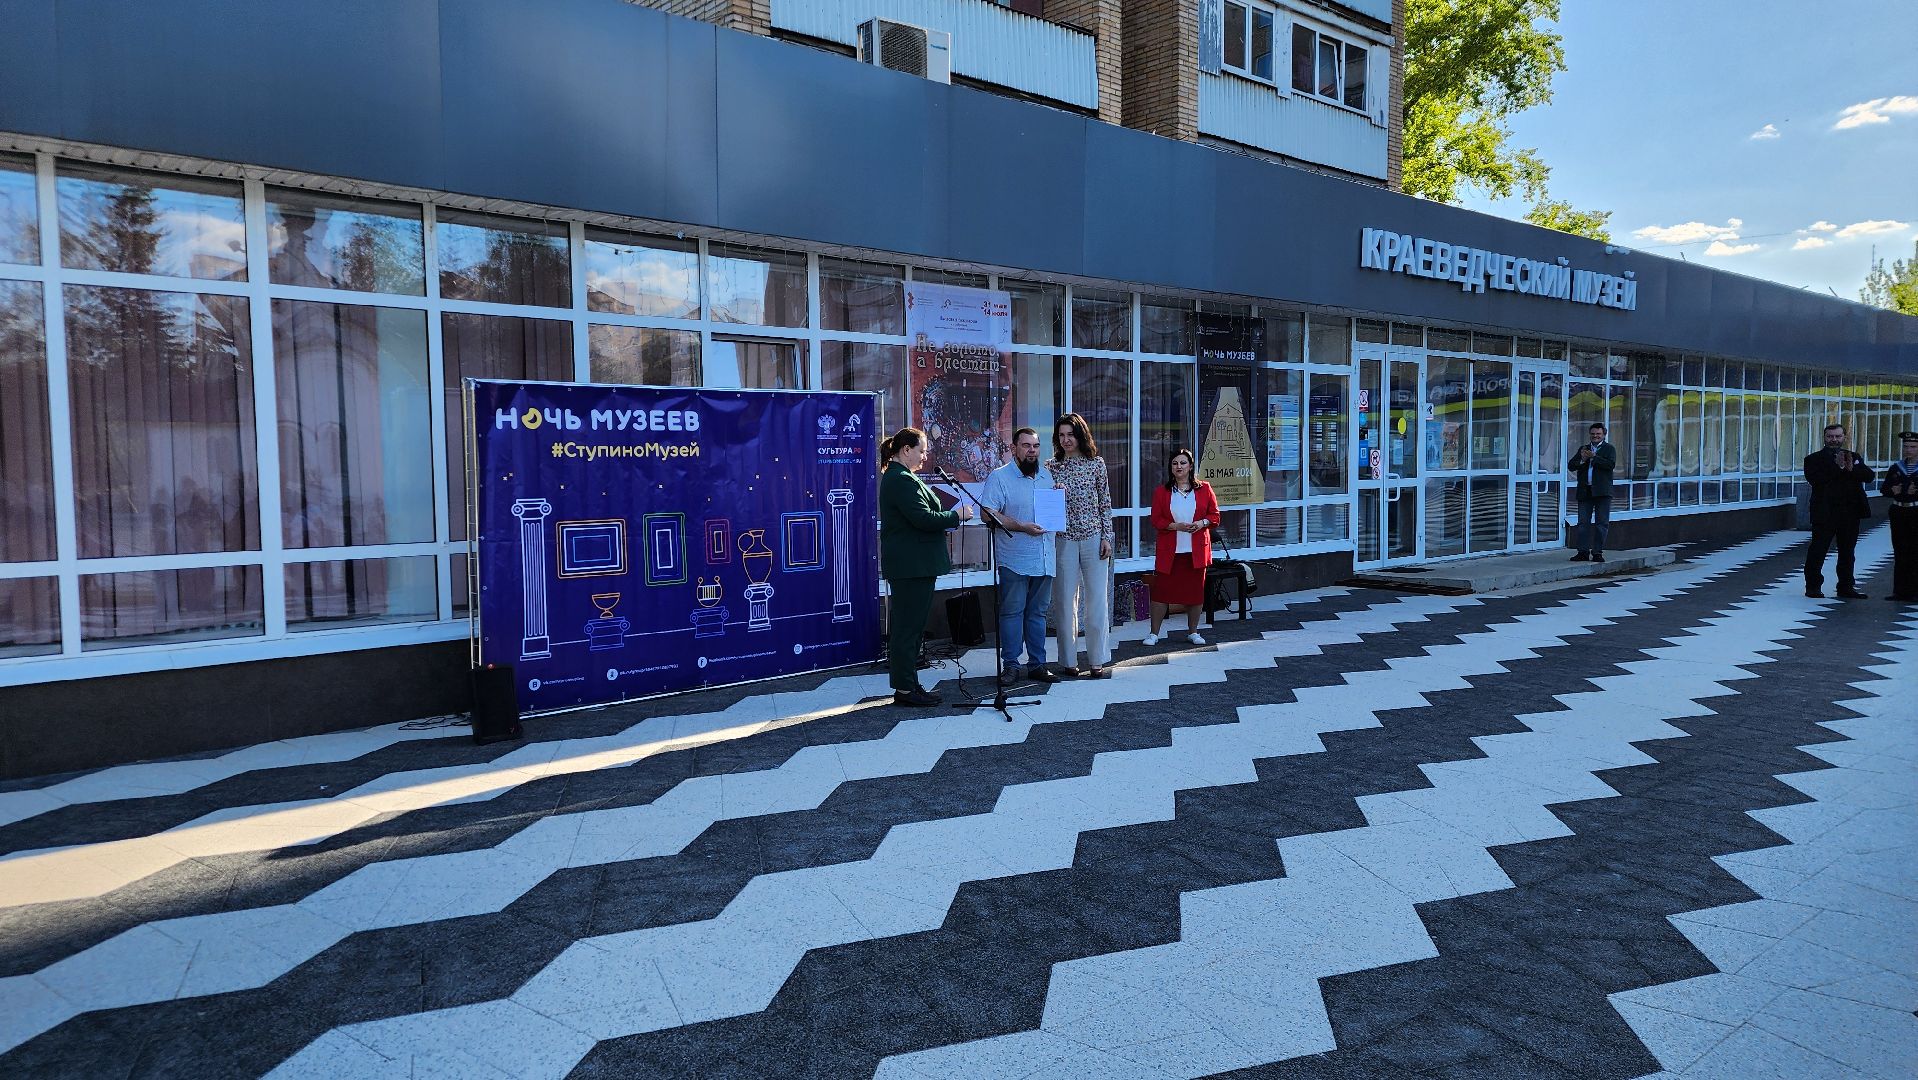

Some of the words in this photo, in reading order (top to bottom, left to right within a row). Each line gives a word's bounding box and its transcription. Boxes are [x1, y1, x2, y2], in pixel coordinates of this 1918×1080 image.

[1361, 227, 1570, 300] КРАЕВЕДЧЕСКИЙ
[1571, 270, 1637, 311] МУЗЕЙ
[917, 355, 927, 368] а
[1203, 349, 1225, 359] НОЧЬ
[1226, 350, 1256, 361] МУЗЕЕВ
[495, 407, 582, 430] НОЧЬ
[590, 409, 700, 431] МУЗЕЕВ
[551, 441, 700, 462] #СтупиноМузей
[1205, 468, 1215, 479] 18
[1217, 468, 1234, 479] МАЯ
